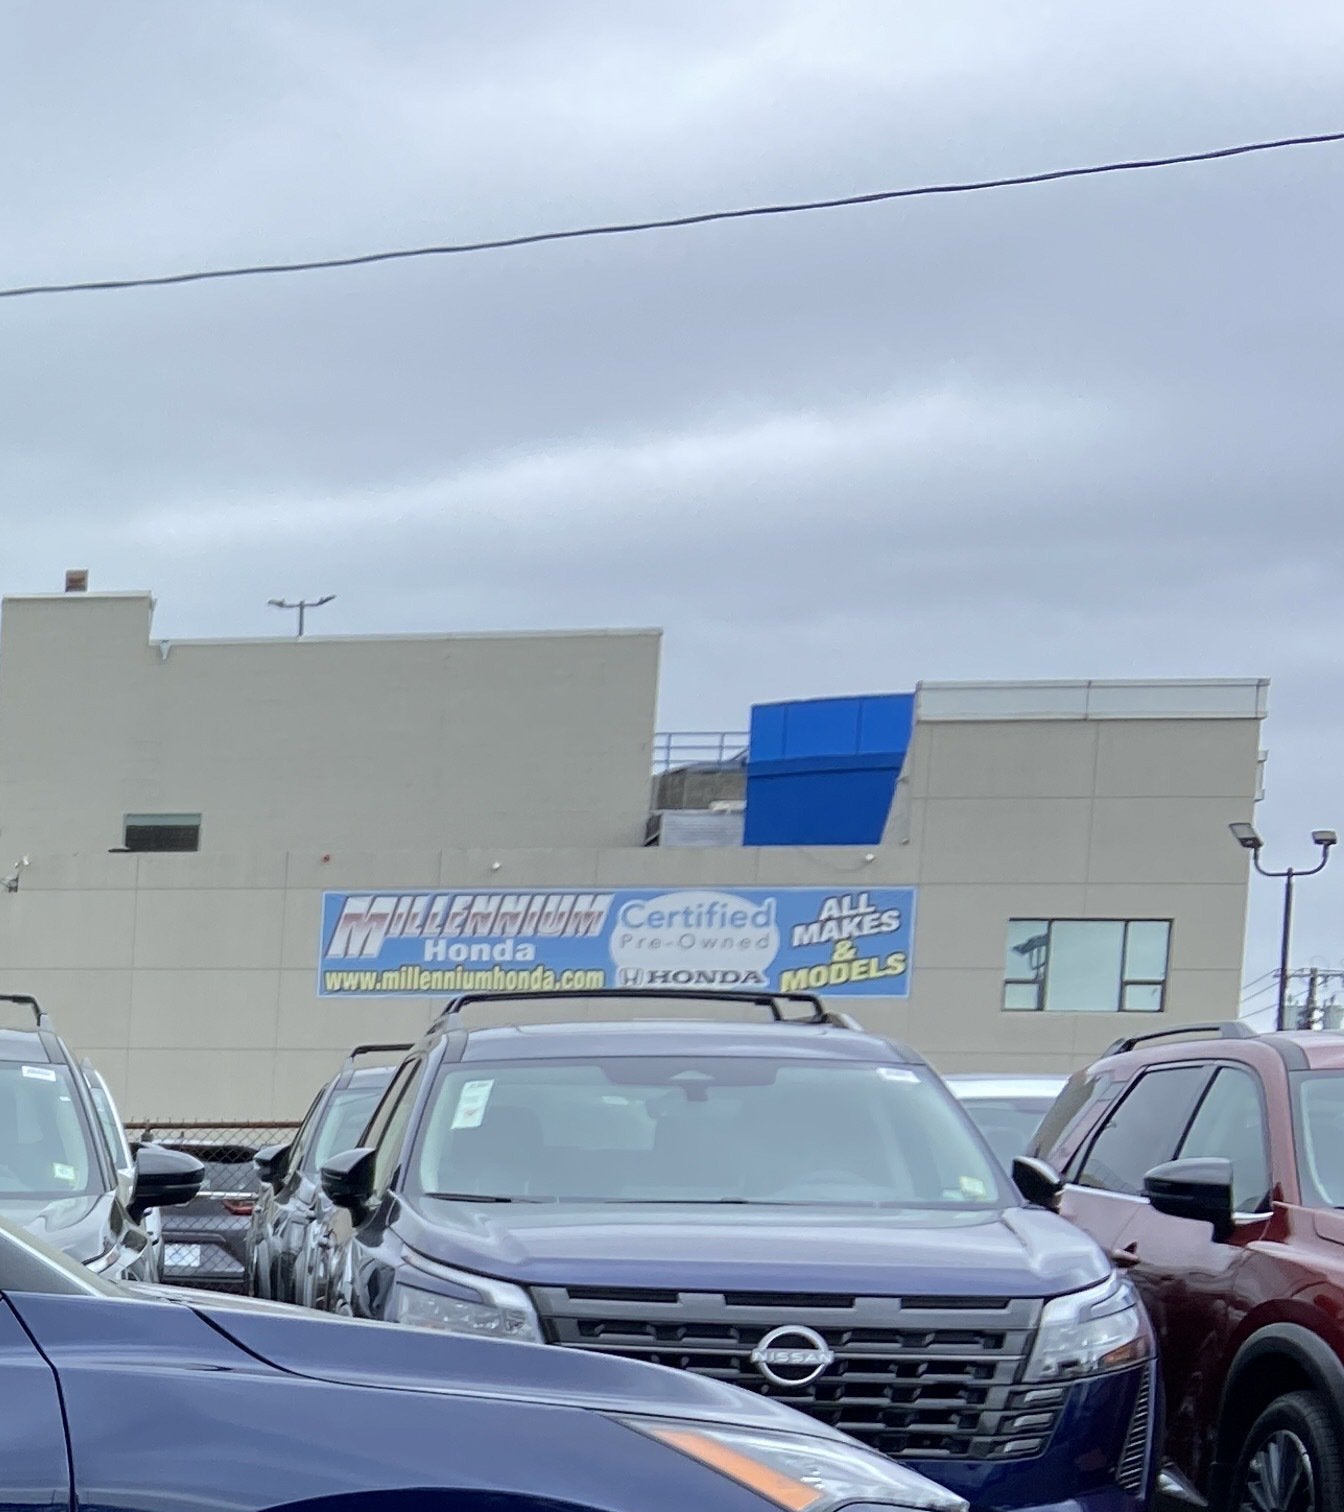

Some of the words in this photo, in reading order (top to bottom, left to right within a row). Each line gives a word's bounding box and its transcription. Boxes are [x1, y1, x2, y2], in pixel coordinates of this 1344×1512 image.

[620, 900, 774, 929] Certified
[819, 892, 876, 921] ALL
[324, 893, 616, 959] MILLENNIUM
[792, 910, 902, 947] MAKES
[423, 938, 536, 961] Honda
[619, 932, 770, 949] Pre-Owned
[832, 938, 857, 961] &
[324, 965, 606, 991] www.millenniumhonda.com
[647, 969, 763, 984] HONDA
[779, 951, 907, 993] MODELS
[751, 1350, 833, 1363] NISSAN
